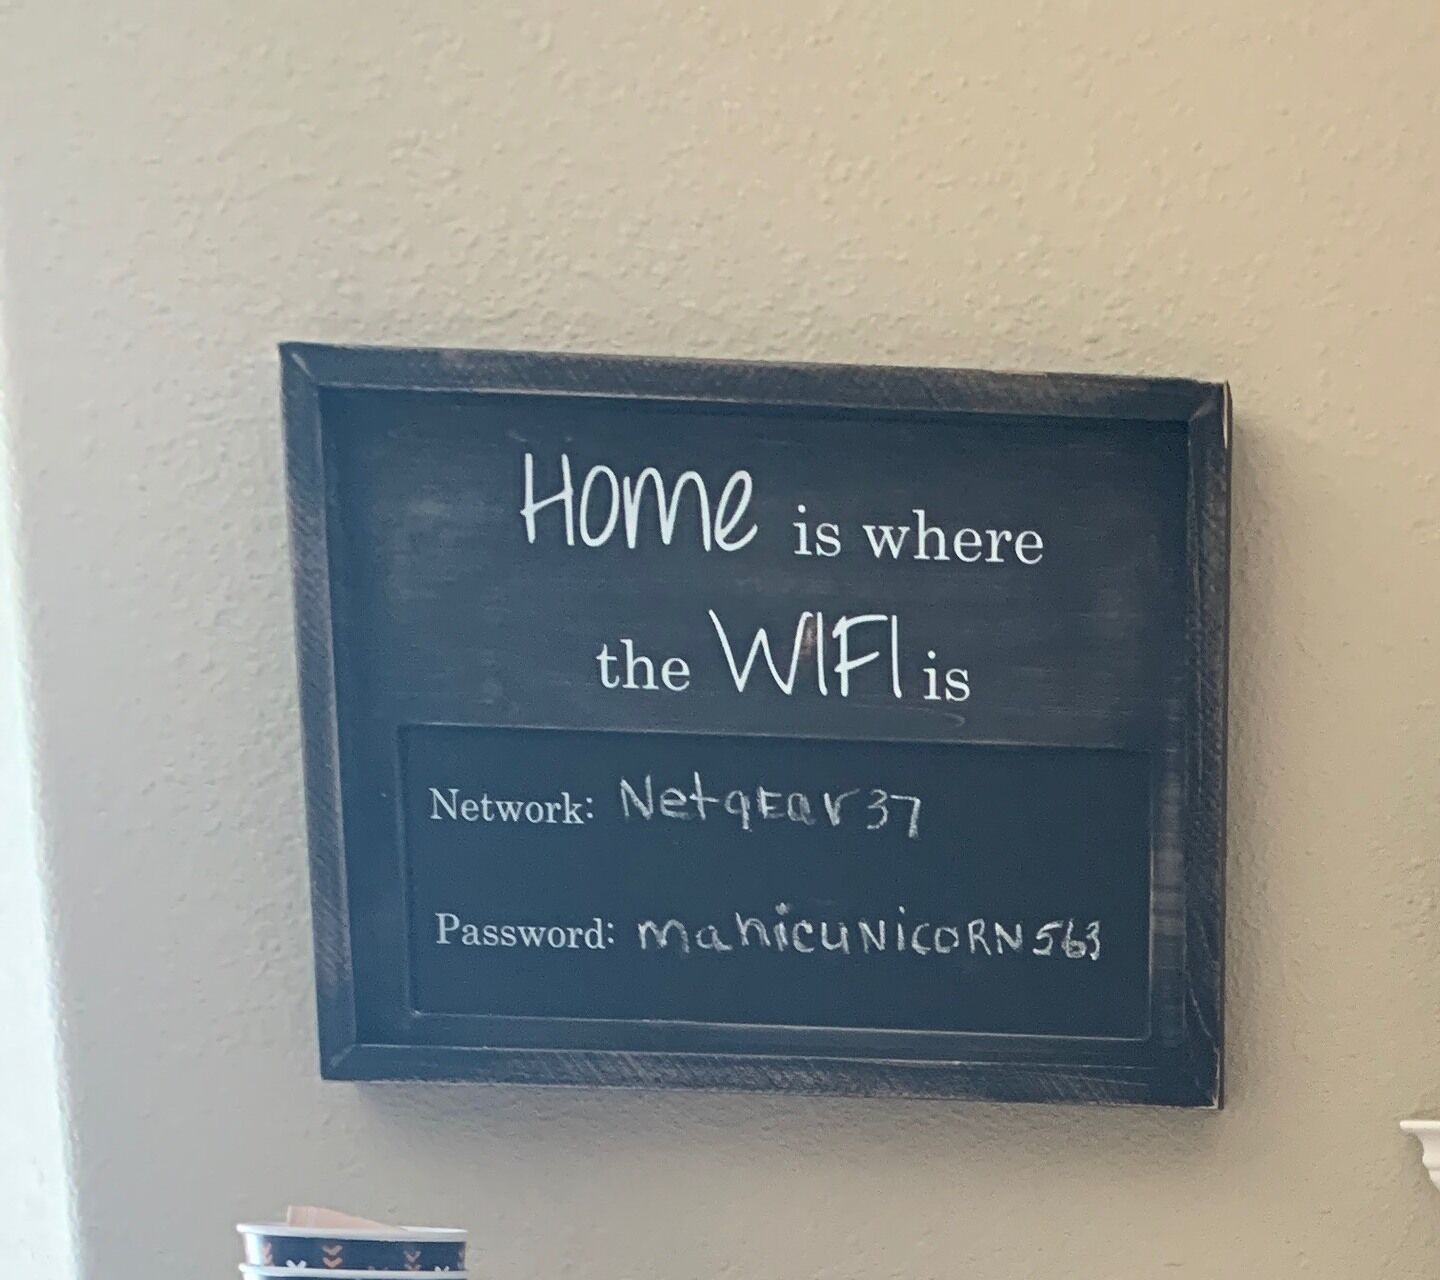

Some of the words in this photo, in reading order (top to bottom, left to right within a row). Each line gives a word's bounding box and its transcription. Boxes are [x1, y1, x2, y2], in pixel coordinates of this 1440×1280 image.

[521, 452, 758, 552] Home
[793, 505, 842, 557] is
[863, 509, 1044, 565] where
[597, 639, 690, 691] the
[709, 608, 903, 699] WIFI
[923, 651, 971, 702] is
[429, 787, 594, 825] Network:
[435, 912, 615, 950] Password:
